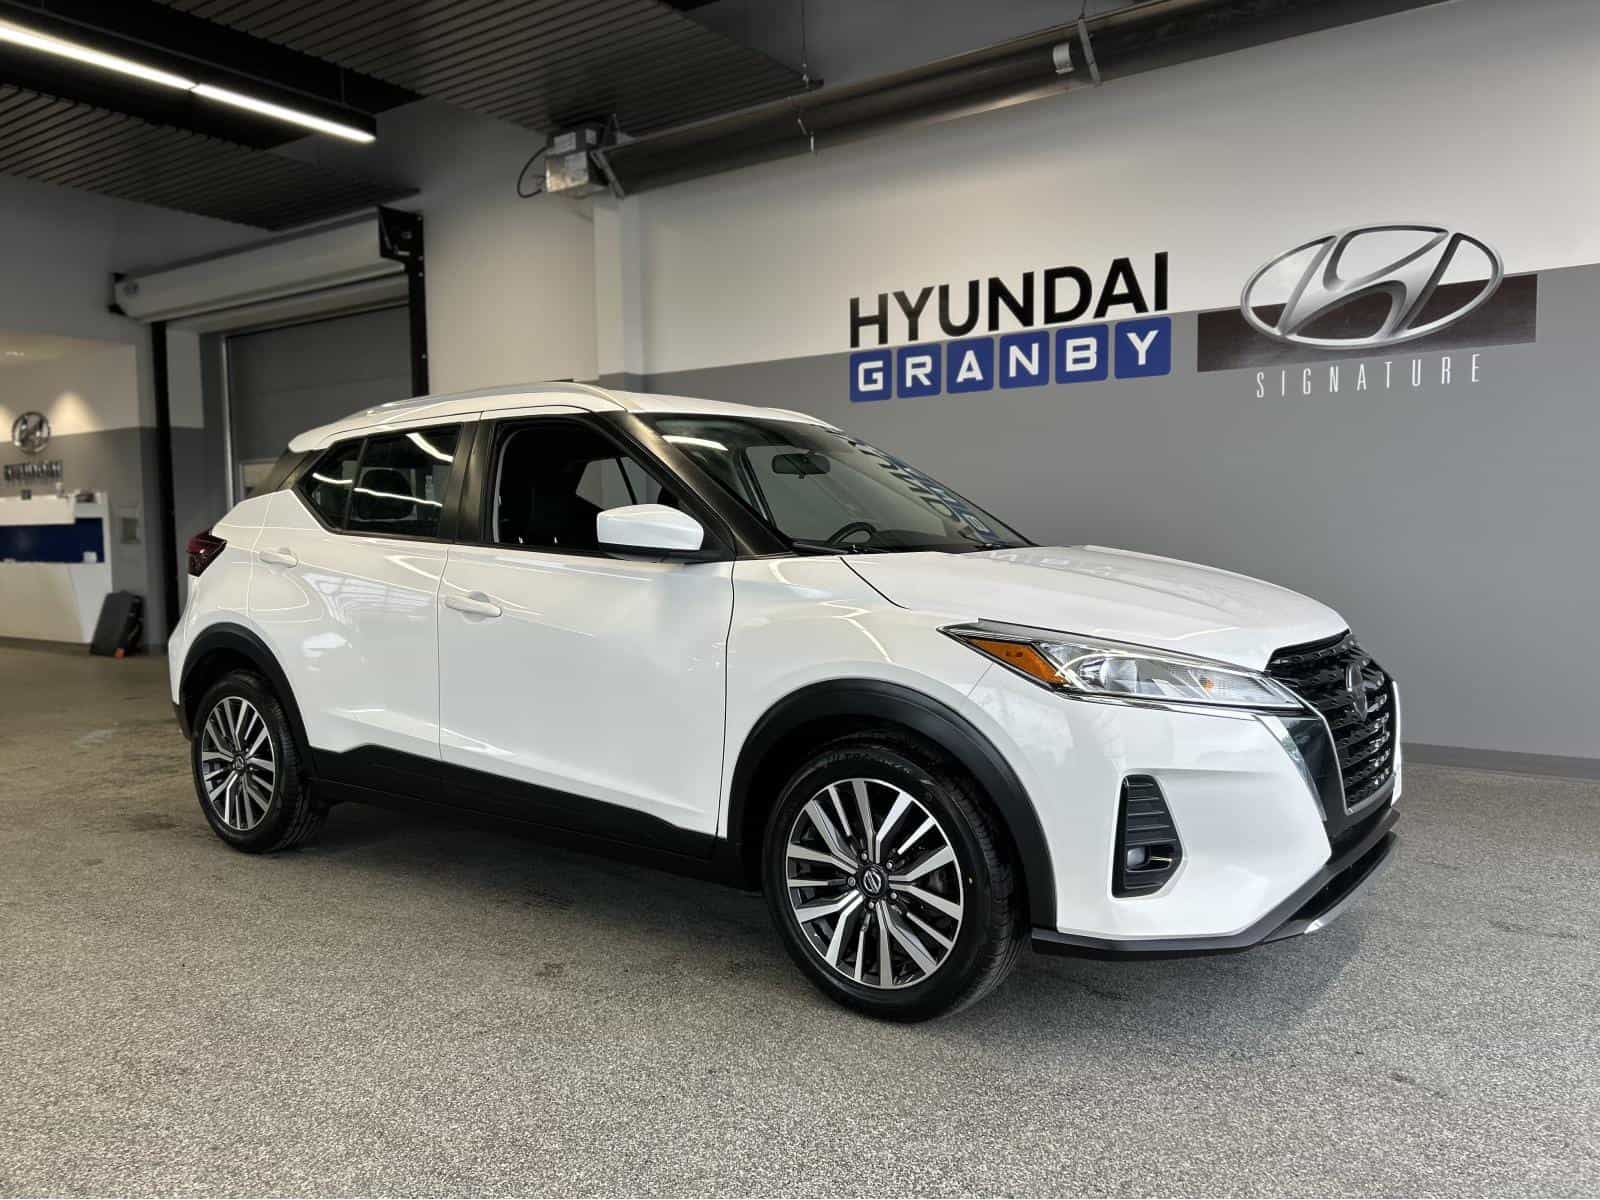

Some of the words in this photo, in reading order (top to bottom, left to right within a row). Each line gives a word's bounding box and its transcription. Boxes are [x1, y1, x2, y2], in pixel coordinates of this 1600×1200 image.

[850, 252, 1168, 348] HYUNDAI
[857, 329, 1160, 392] GRANBY
[1256, 353, 1481, 398] SIGNATURE
